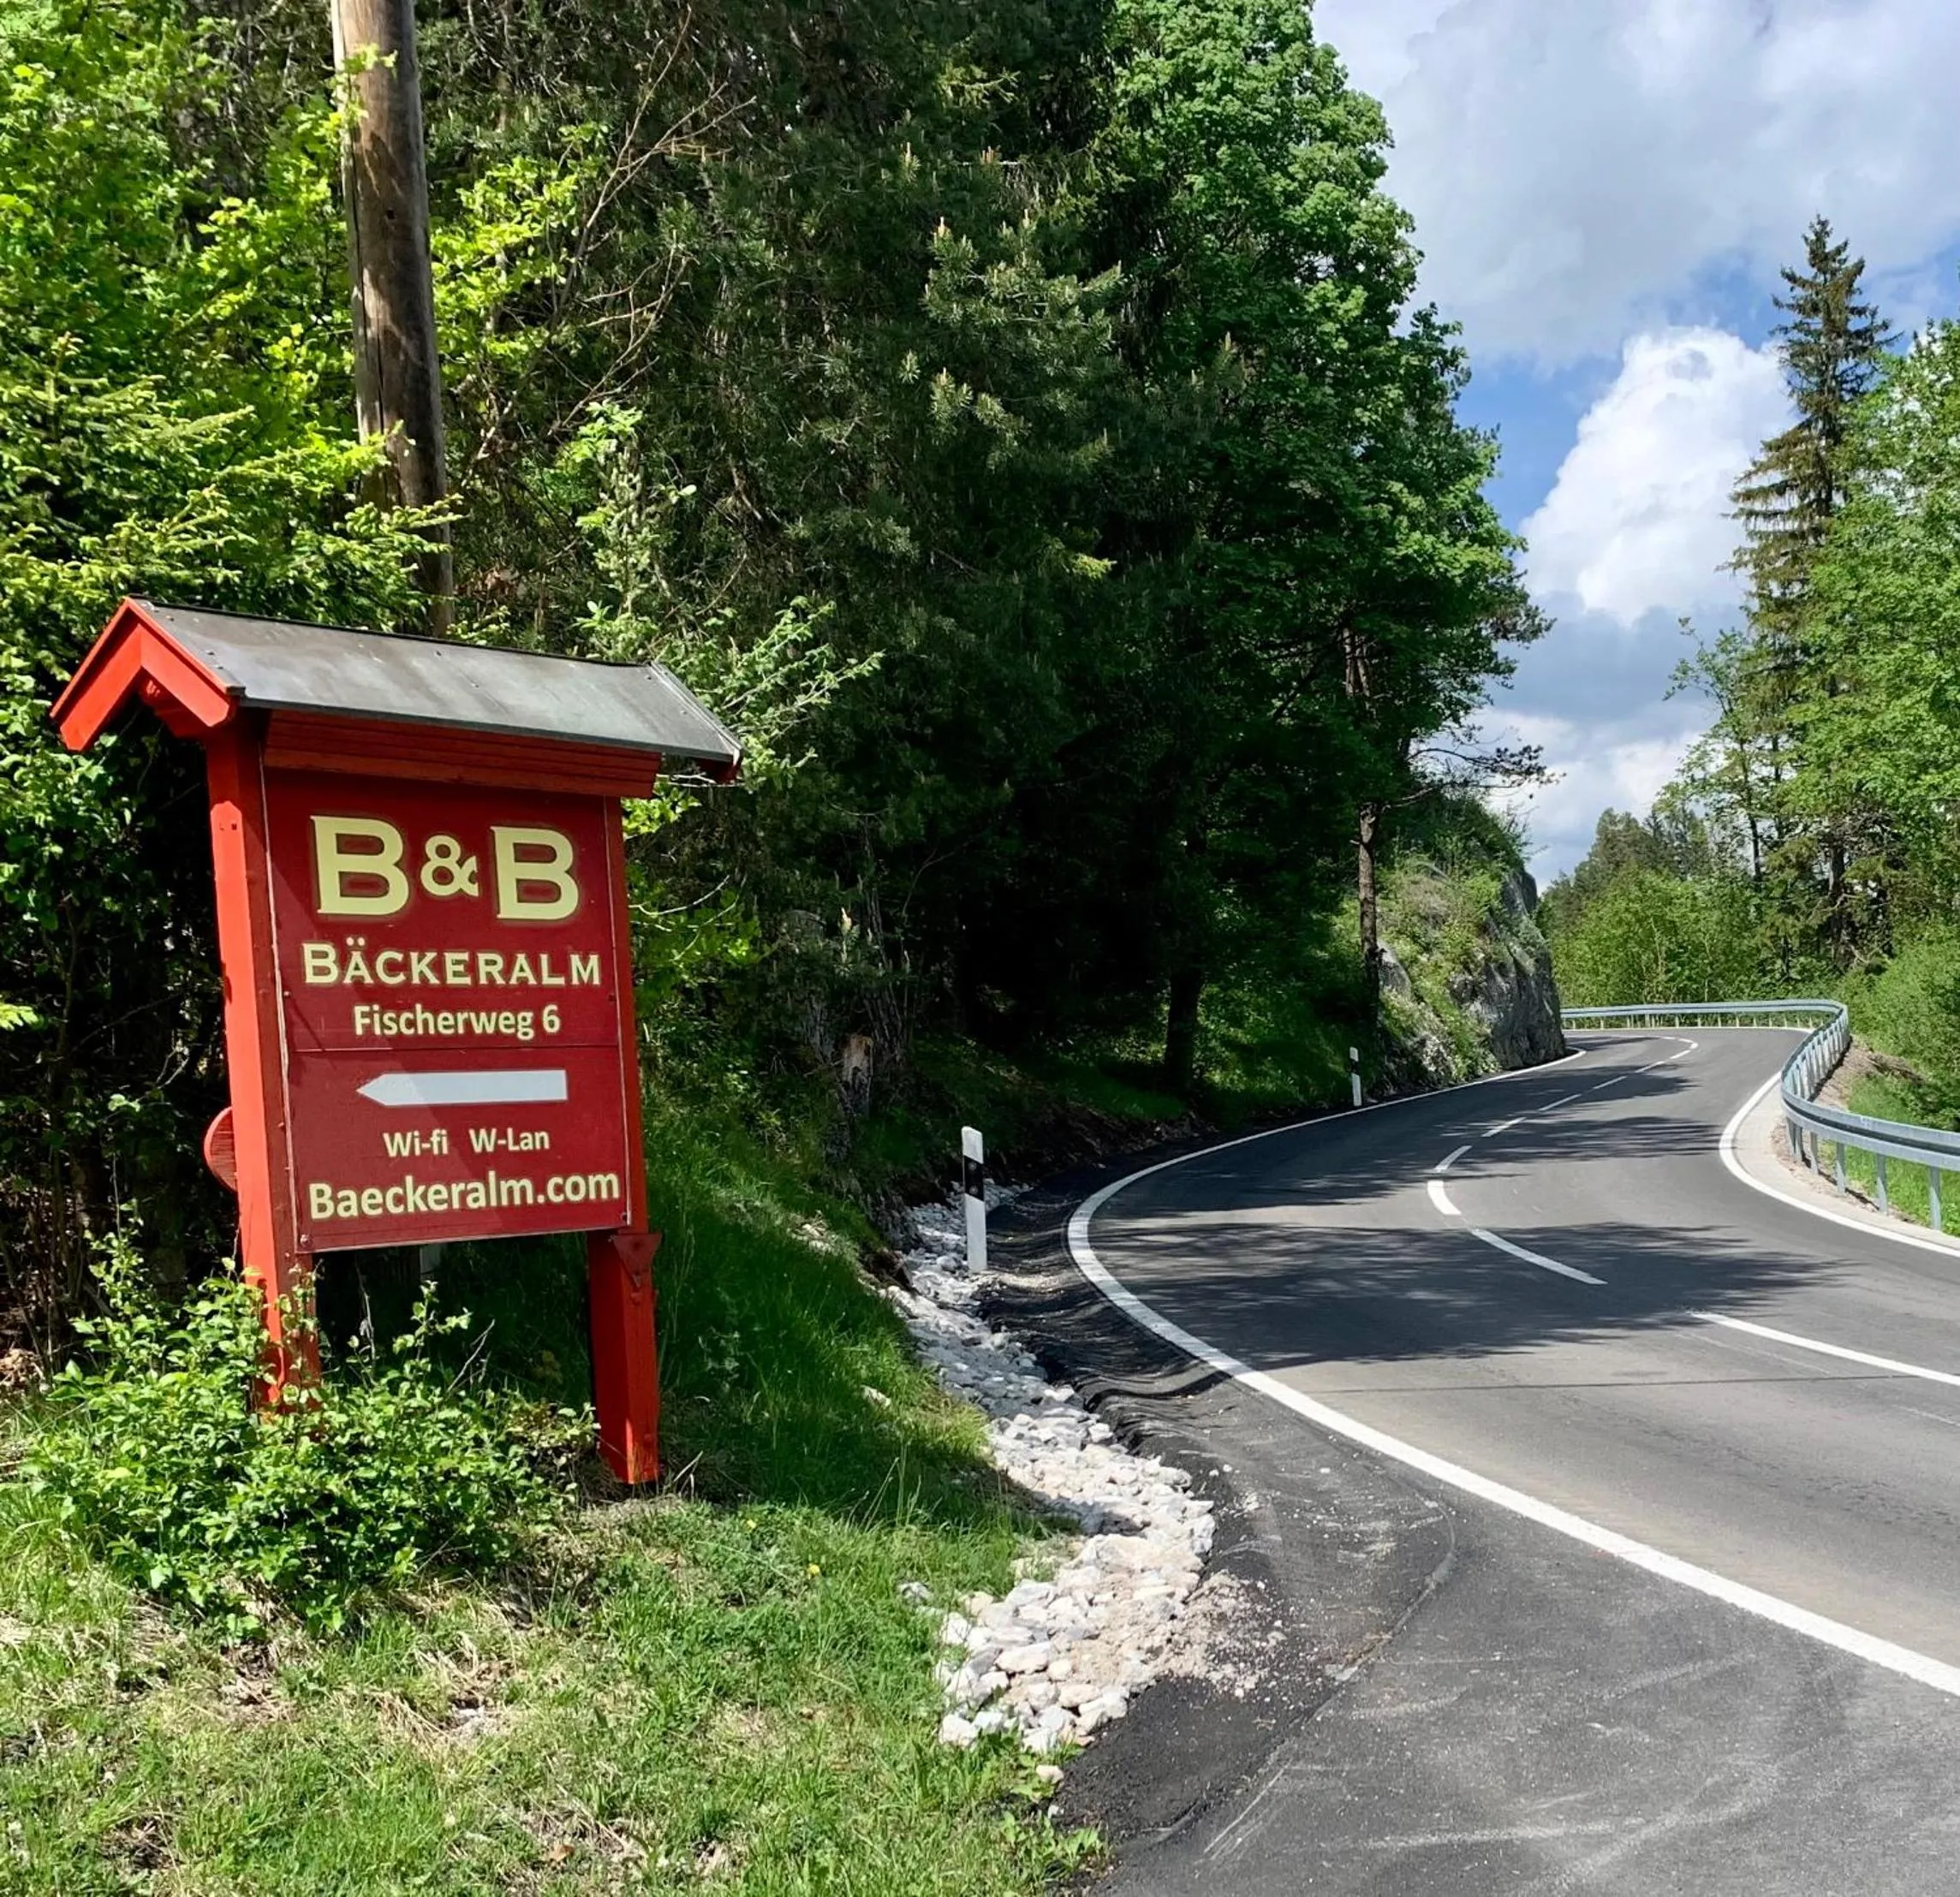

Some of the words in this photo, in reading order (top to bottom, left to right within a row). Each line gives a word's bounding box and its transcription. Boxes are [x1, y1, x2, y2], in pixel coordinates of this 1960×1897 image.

[309, 814, 580, 920] B&B
[302, 937, 600, 985] BÄCKERALM
[353, 1005, 534, 1040] Fischerweg
[542, 1004, 561, 1032] 6
[383, 1128, 449, 1157] Wi-fi
[468, 1127, 550, 1153] W-Lan
[308, 1170, 620, 1220] Baeckeralm.com
